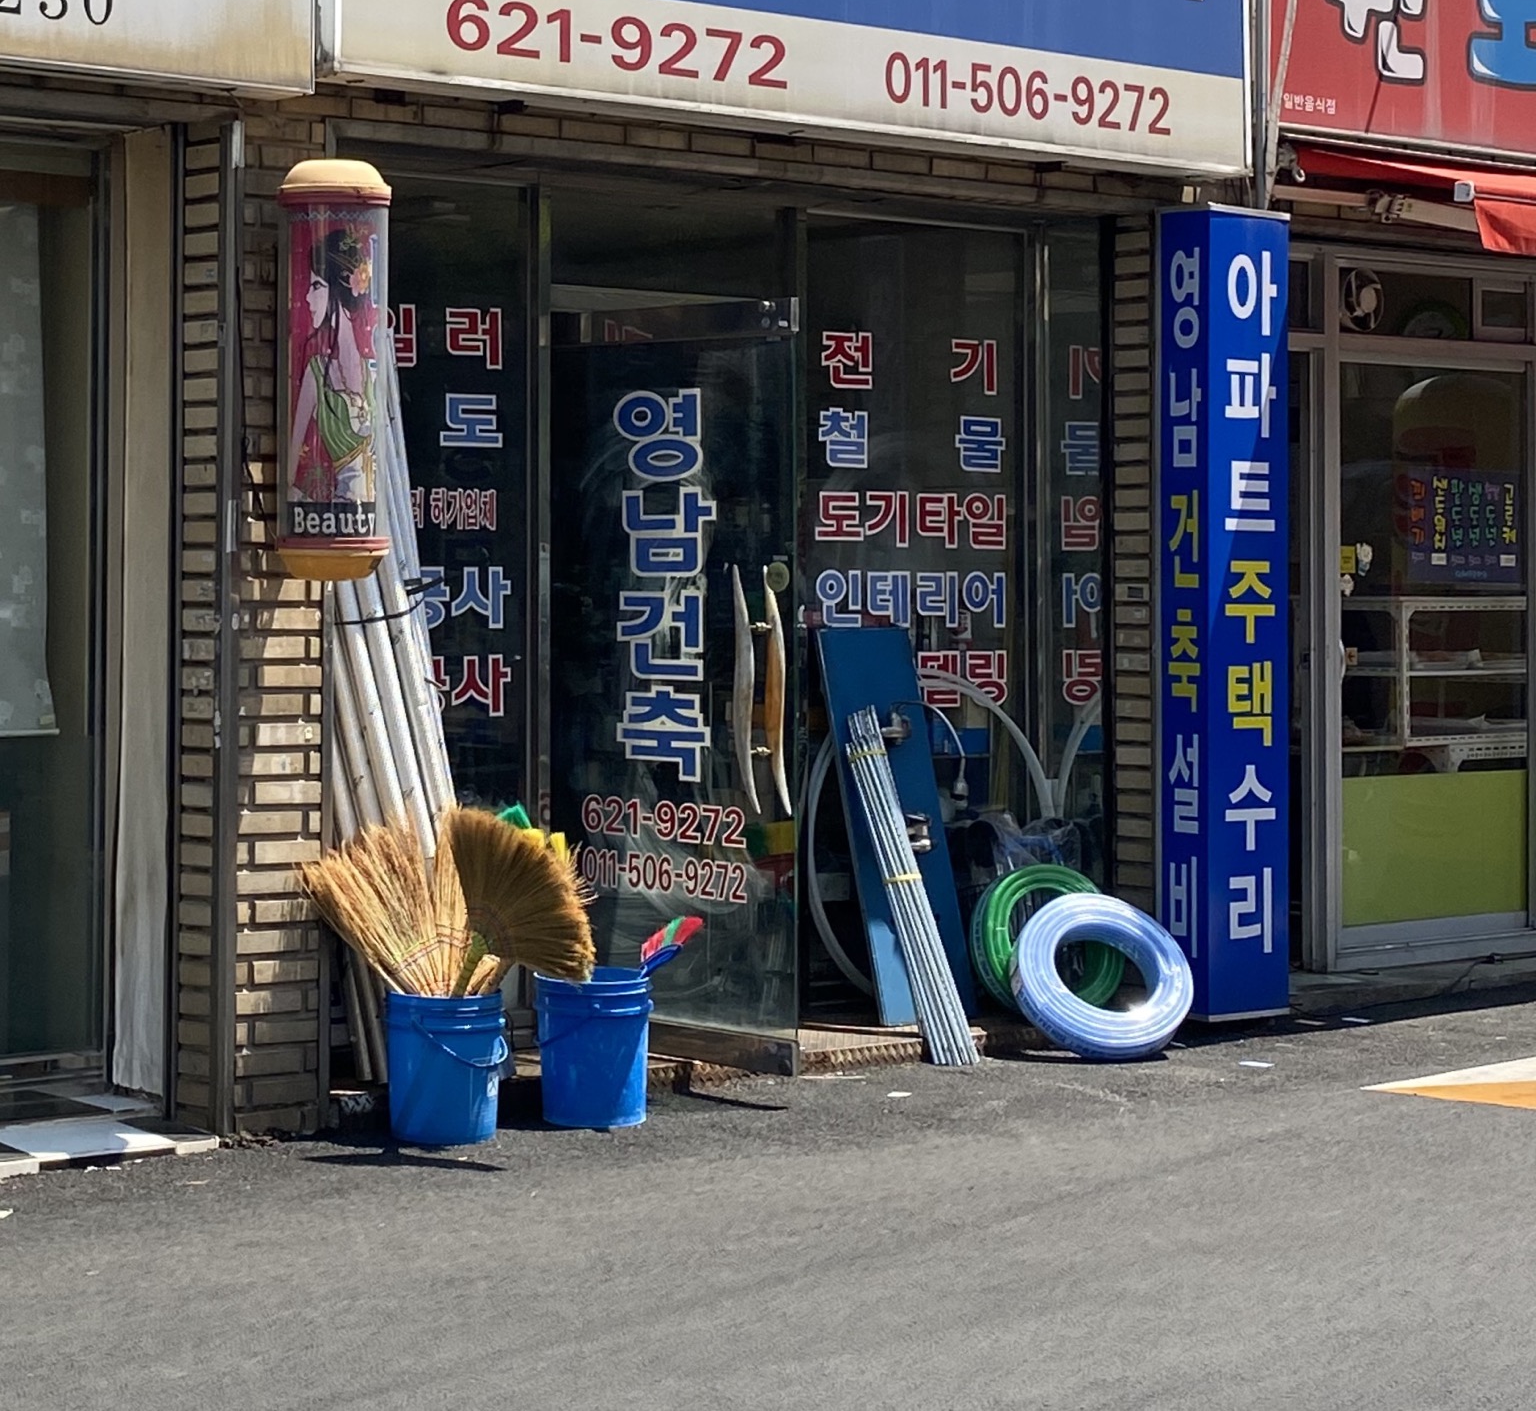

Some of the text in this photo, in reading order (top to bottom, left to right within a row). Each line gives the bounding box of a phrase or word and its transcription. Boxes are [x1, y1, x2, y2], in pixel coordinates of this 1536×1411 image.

[884, 50, 1172, 137] 011-506-9272
[1283, 92, 1336, 115] 일반음식점
[294, 504, 375, 537] Beauty
[815, 491, 1006, 550] 도기타일
[613, 388, 717, 783] 영남건축
[816, 569, 1006, 629] 인테리어
[582, 793, 748, 849] 621-9272
[580, 847, 748, 905] 011-506-9272
